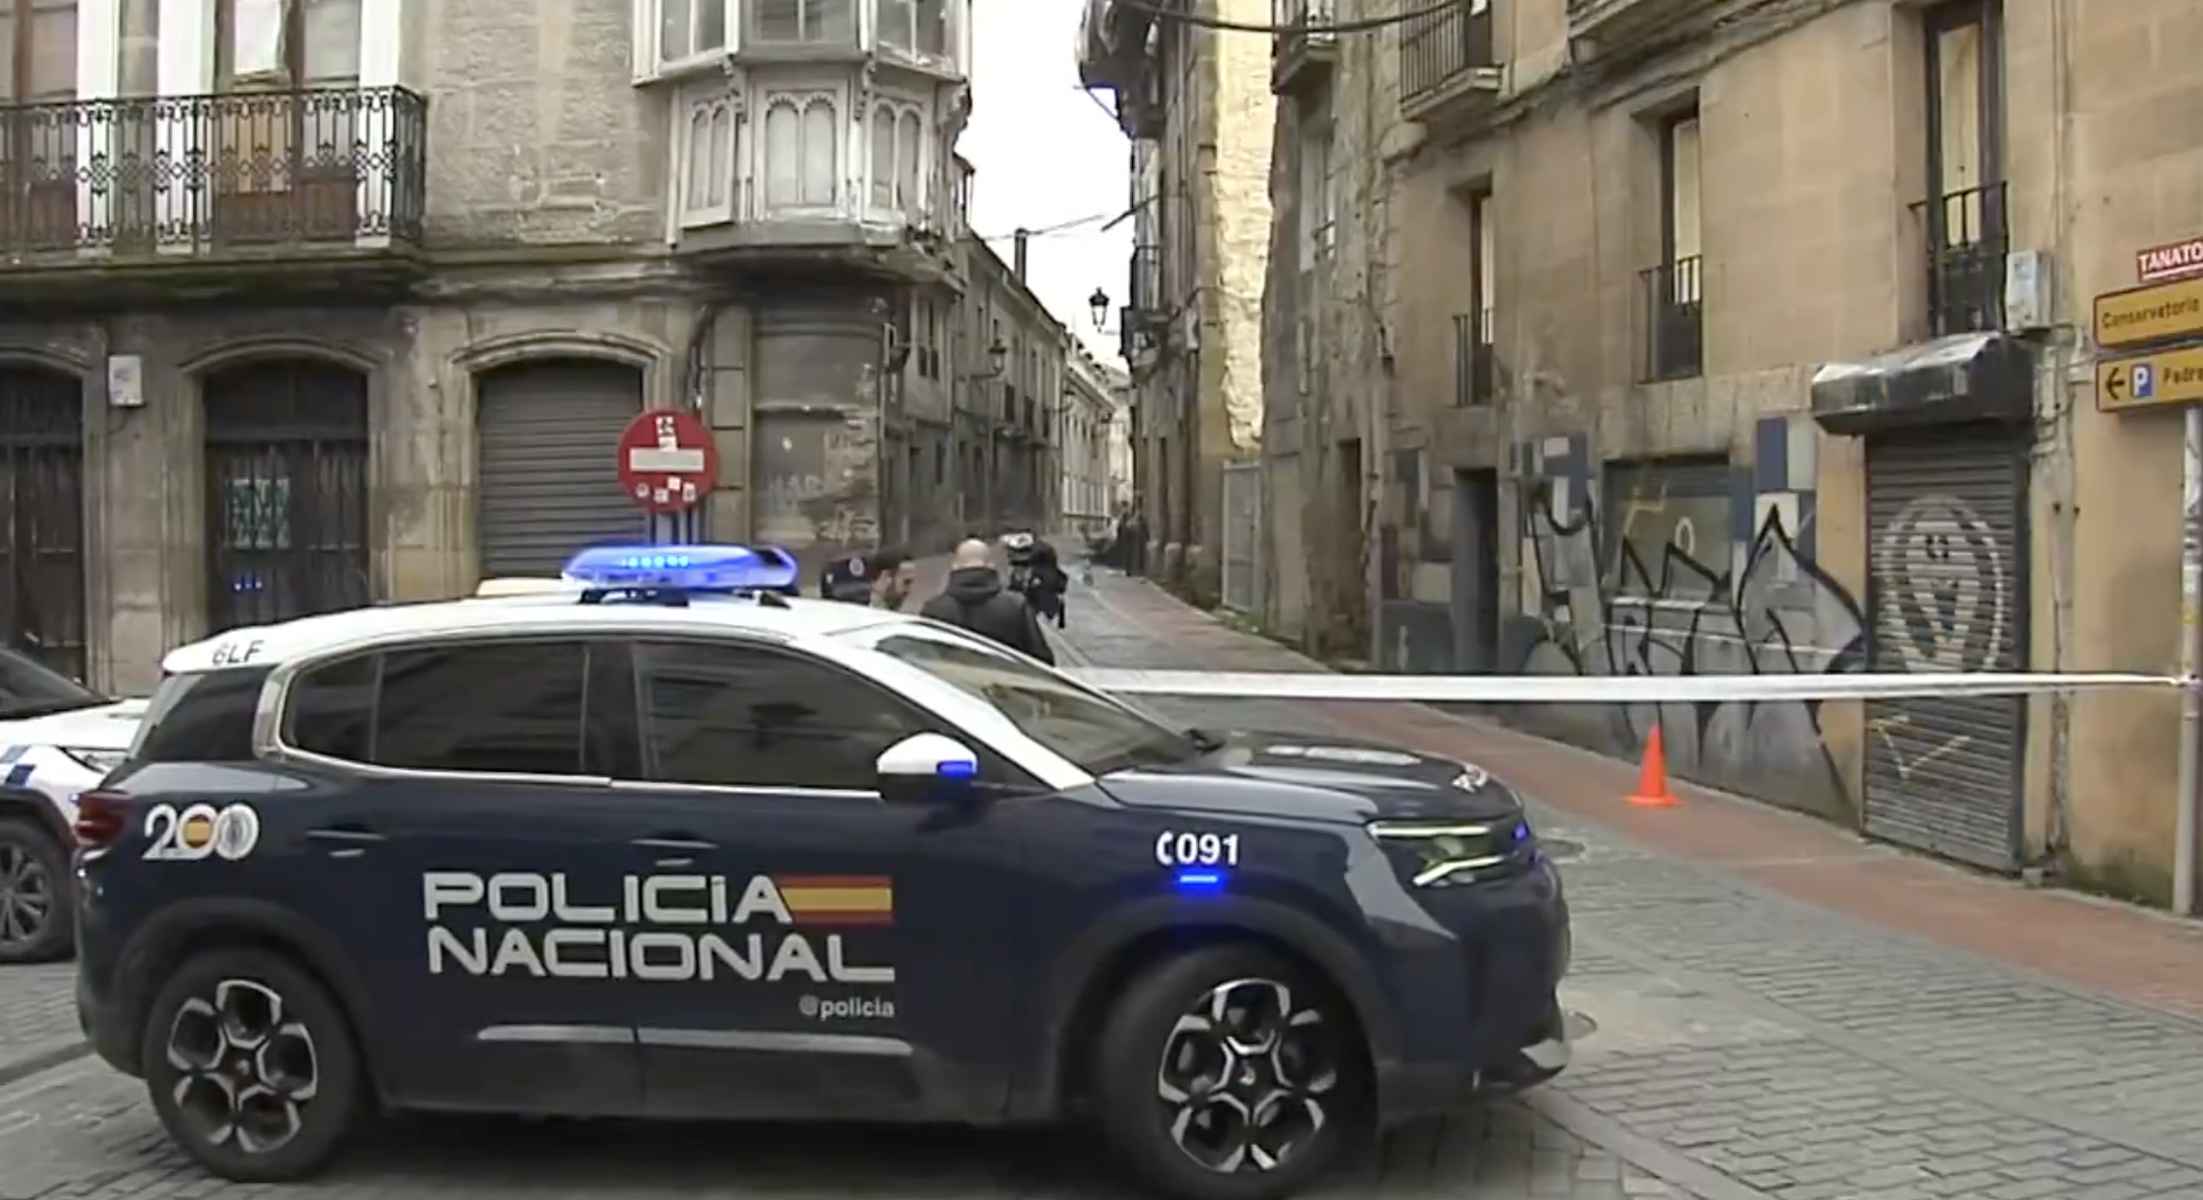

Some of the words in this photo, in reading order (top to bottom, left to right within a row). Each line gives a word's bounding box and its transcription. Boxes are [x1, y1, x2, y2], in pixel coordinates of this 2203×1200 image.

[2133, 367, 2149, 397] P
[142, 803, 259, 860] 200
[428, 926, 895, 983] NACIONAL
